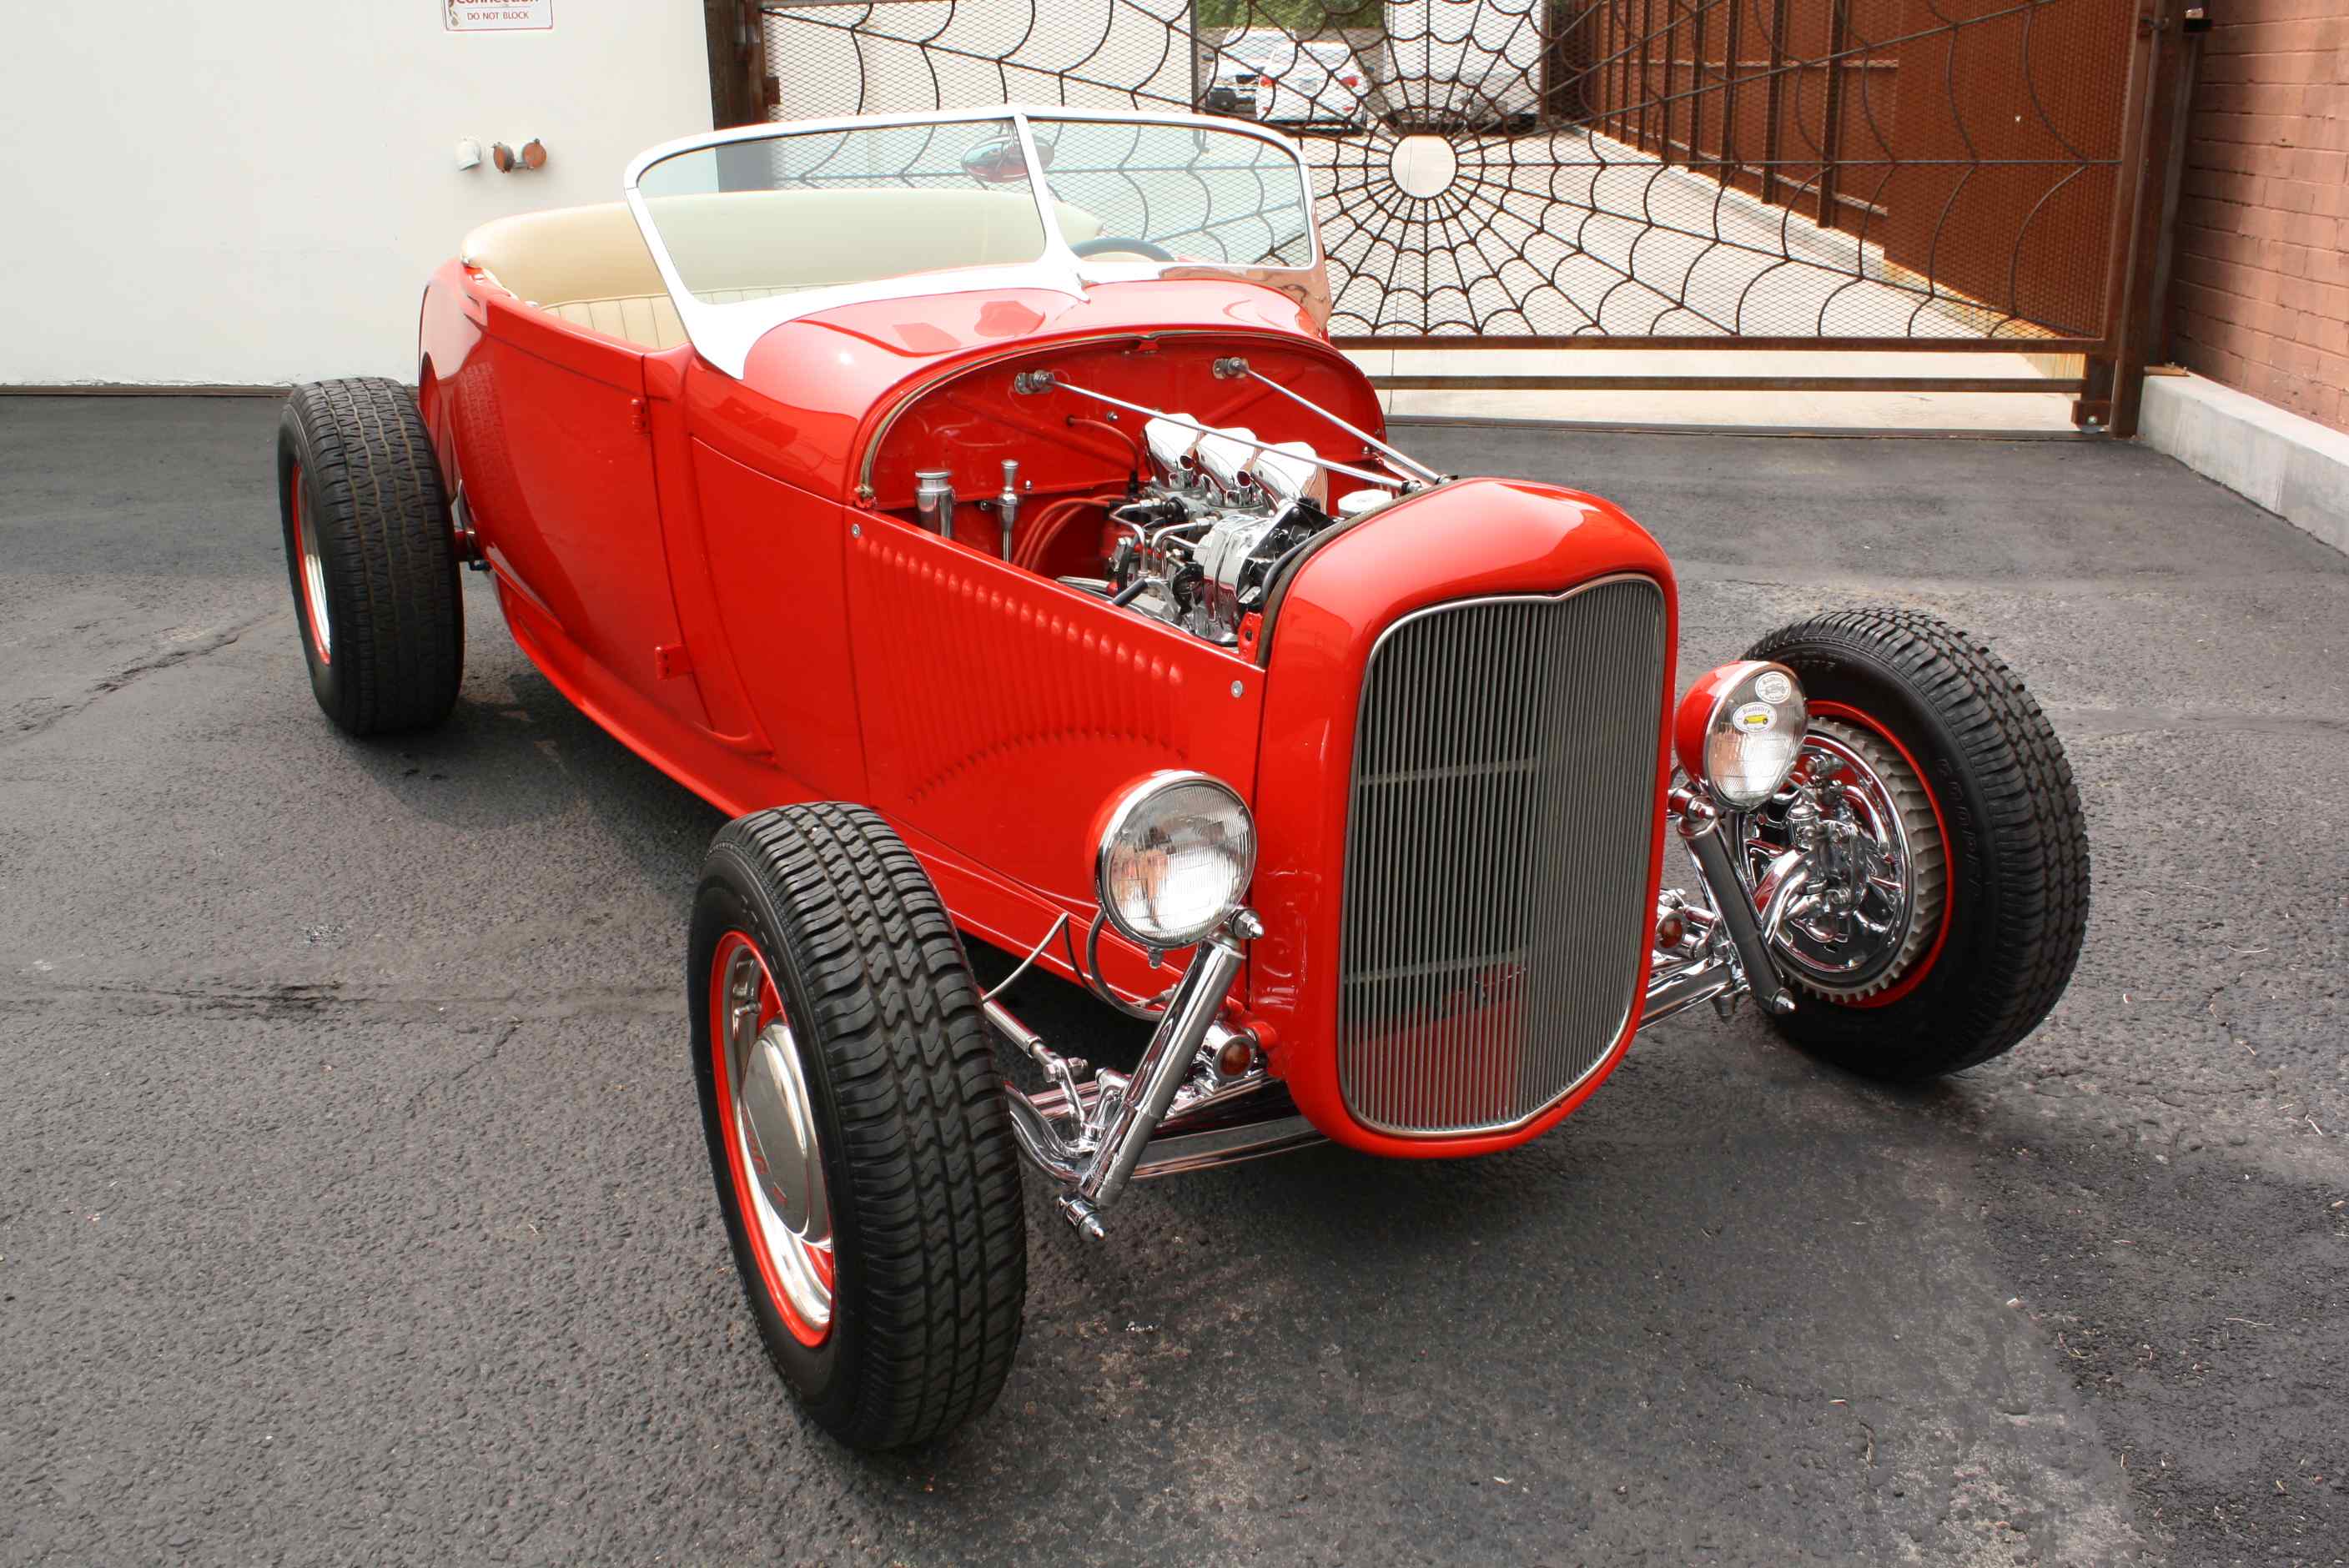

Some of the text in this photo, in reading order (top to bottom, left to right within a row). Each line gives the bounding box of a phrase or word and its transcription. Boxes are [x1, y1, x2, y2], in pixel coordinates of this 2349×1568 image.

[467, 11, 529, 20] DO NOT BLOCK
